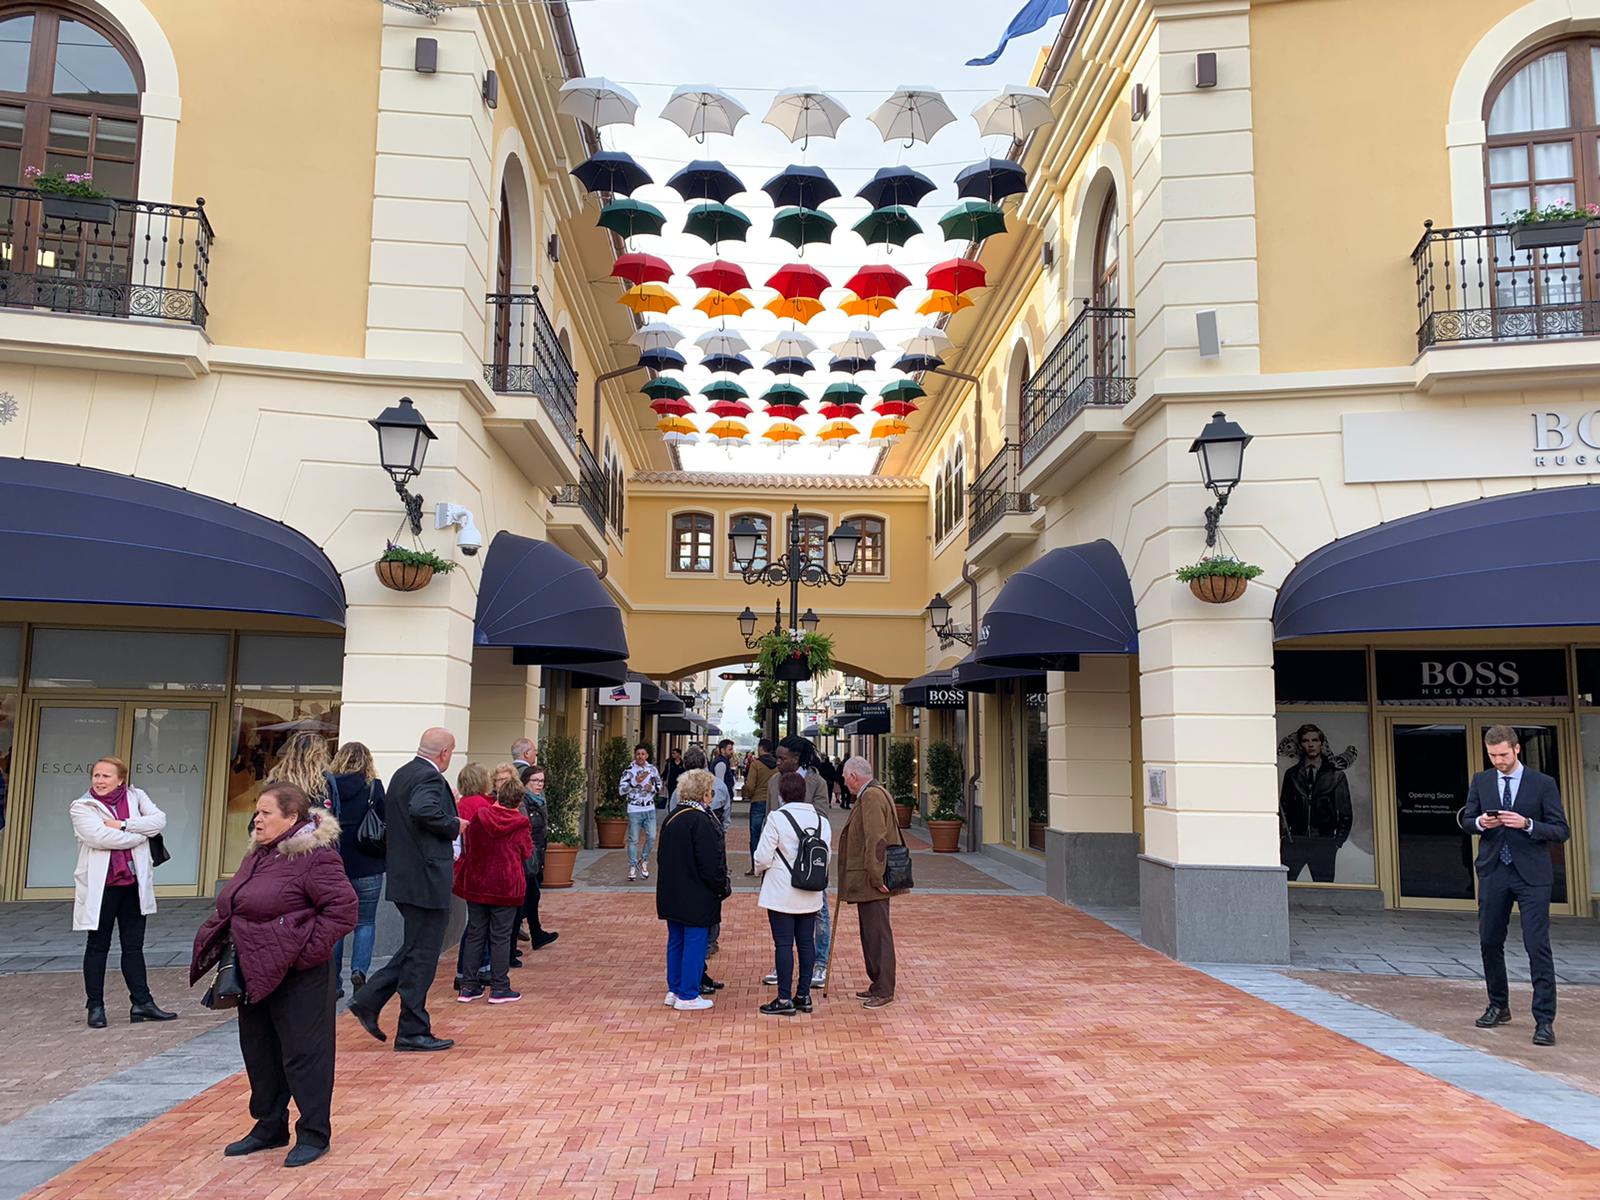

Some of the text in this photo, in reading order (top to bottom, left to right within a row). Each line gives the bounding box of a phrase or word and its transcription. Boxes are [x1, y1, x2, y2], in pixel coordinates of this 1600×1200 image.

[1420, 661, 1520, 686] BOSS
[929, 690, 964, 701] BOSS
[135, 763, 199, 774] ESCADA
[1408, 791, 1454, 800] Opening Soon
